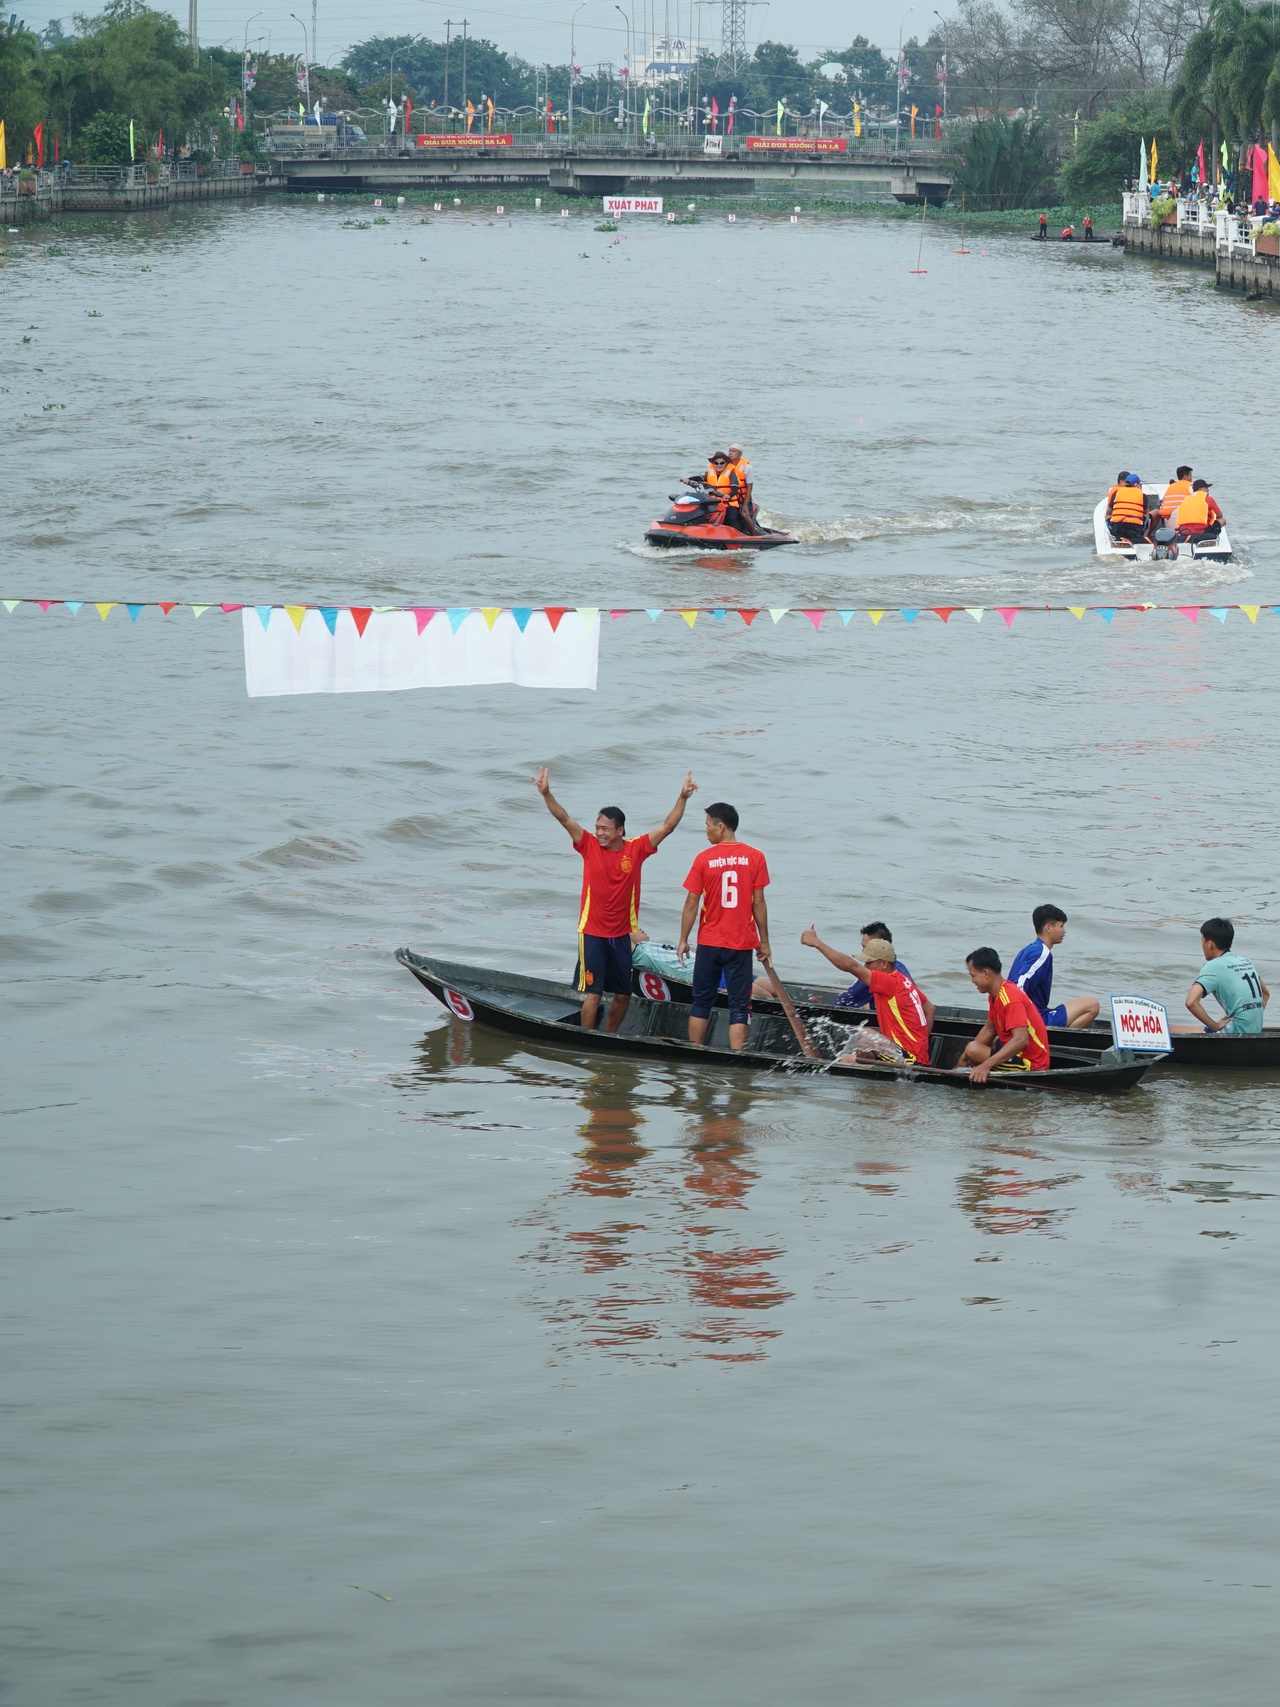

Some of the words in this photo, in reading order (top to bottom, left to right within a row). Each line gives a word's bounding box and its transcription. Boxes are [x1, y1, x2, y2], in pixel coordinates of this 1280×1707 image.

[721, 870, 738, 909] 6
[644, 973, 665, 1001] 8
[1241, 971, 1262, 999] 11
[1120, 1009, 1142, 1038] MỘC
[1142, 1010, 1163, 1035] HÓA
